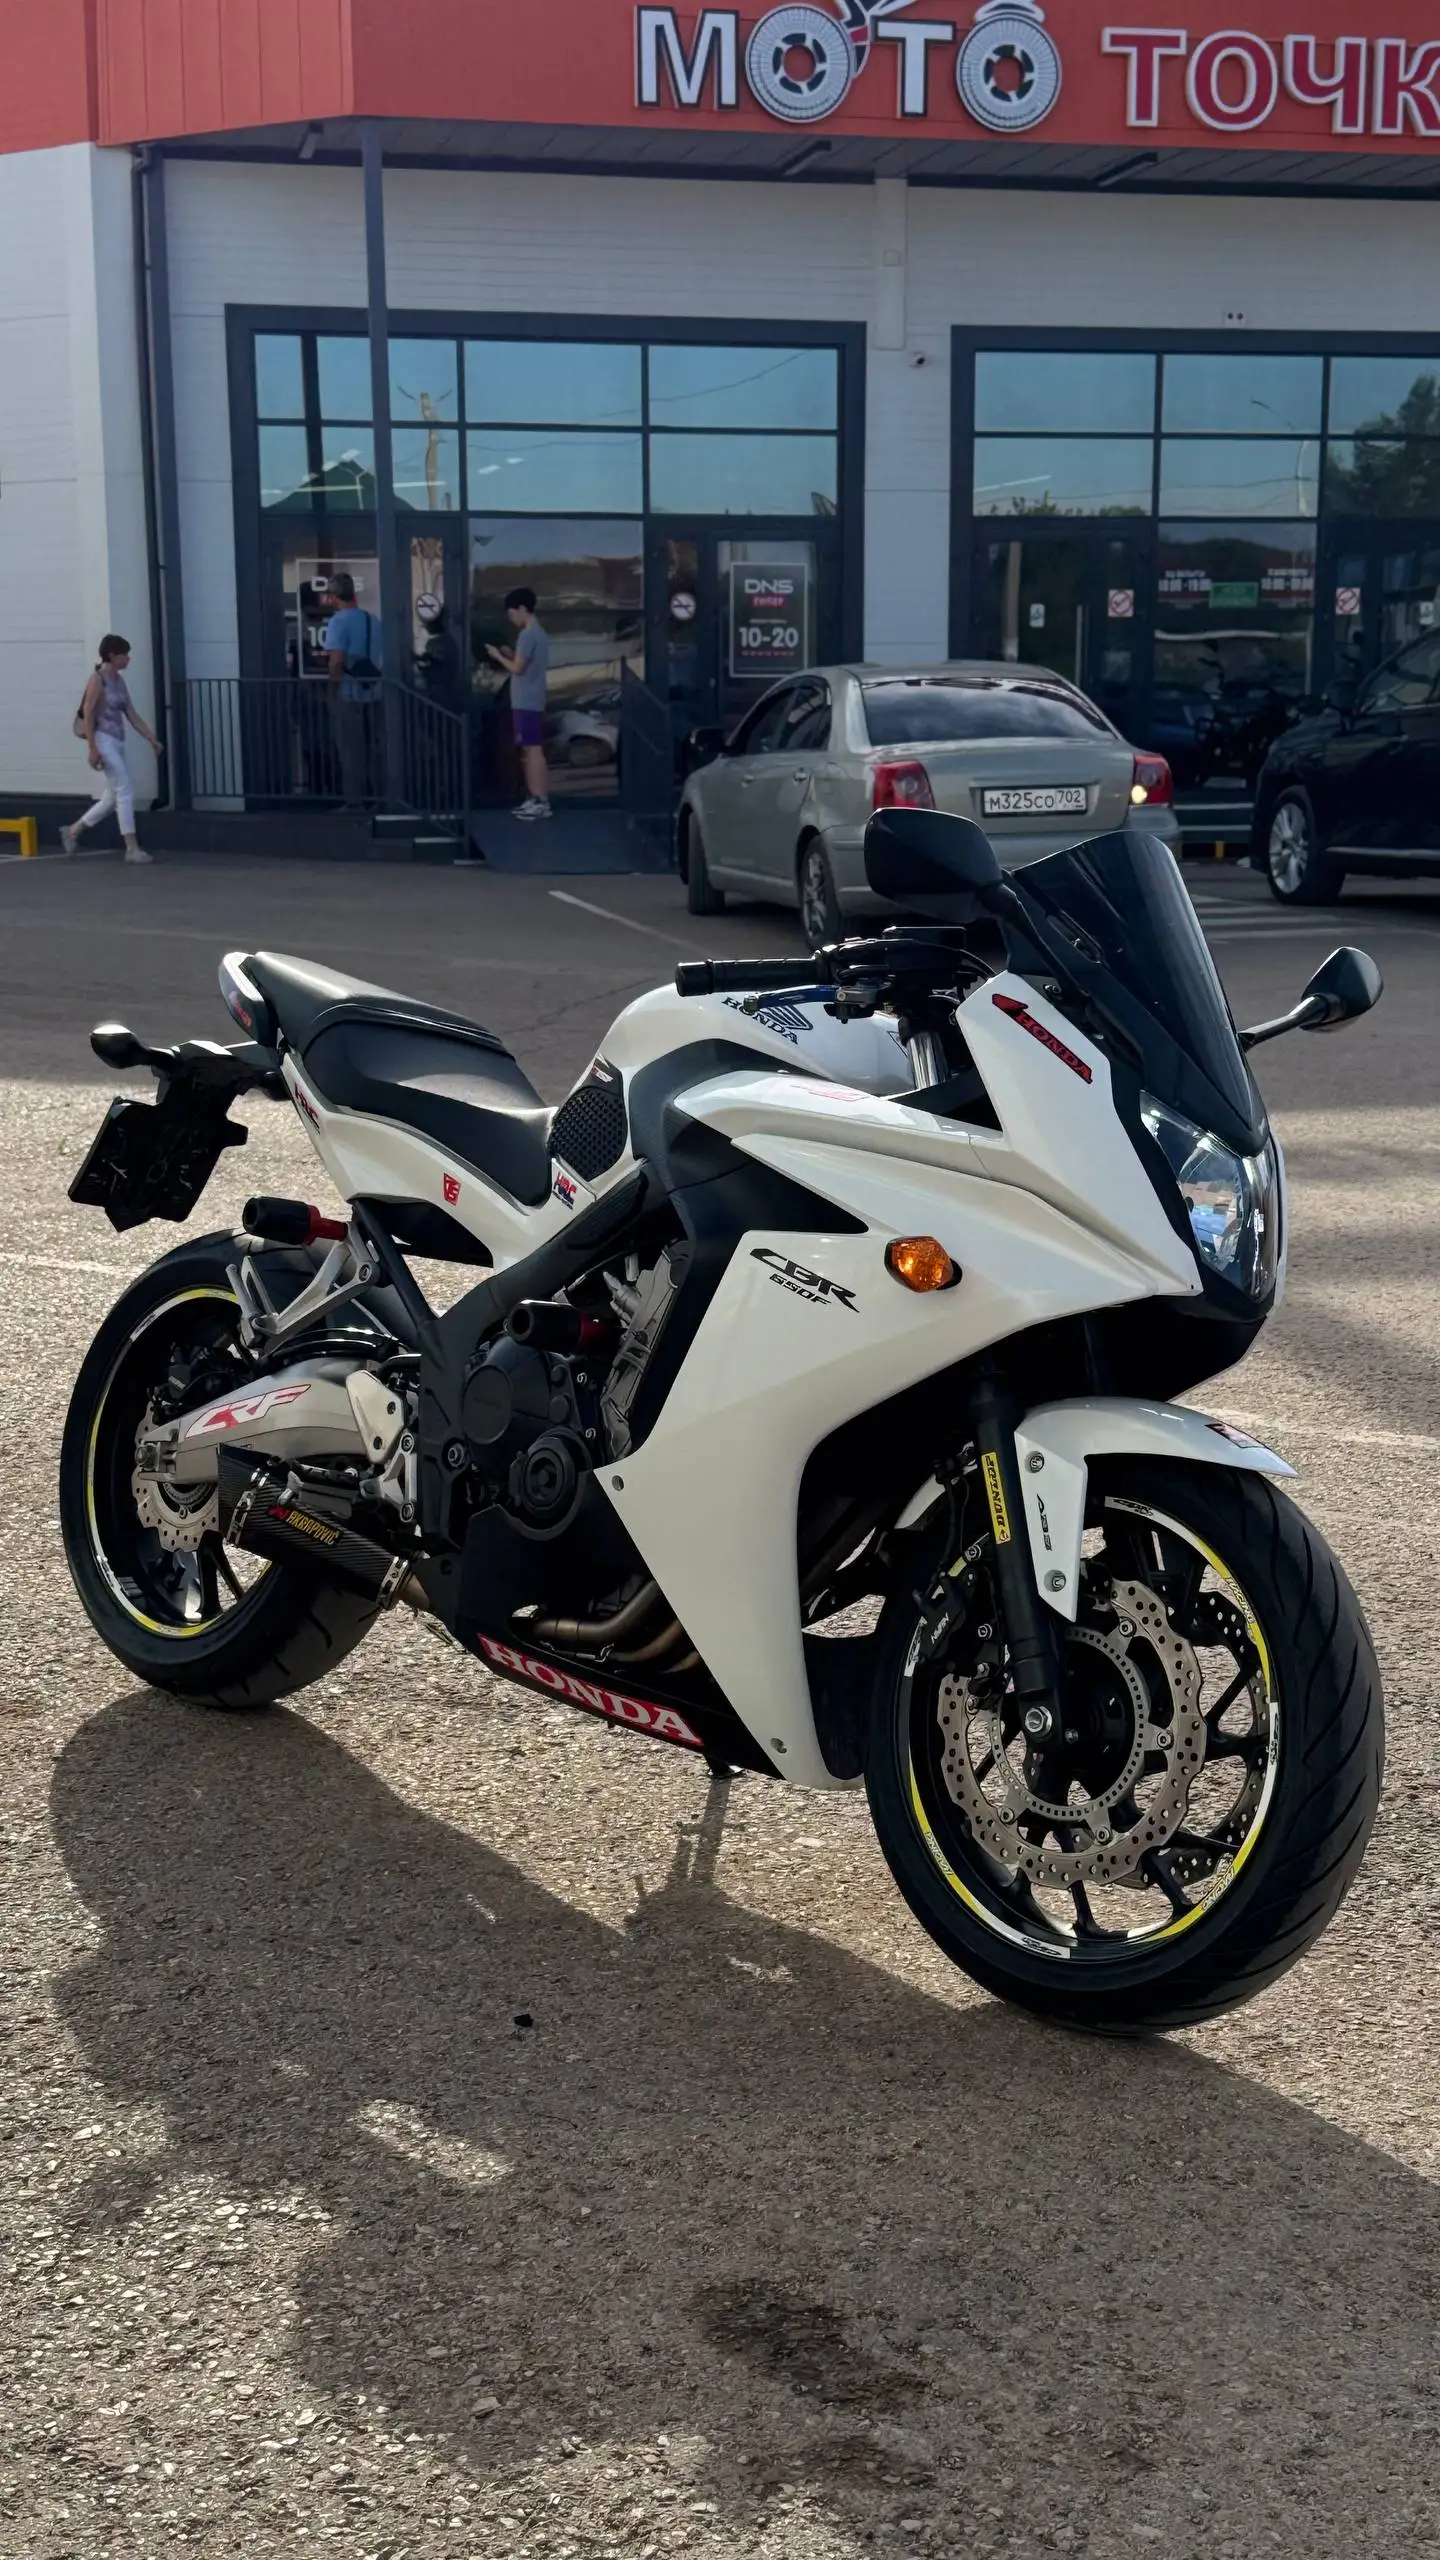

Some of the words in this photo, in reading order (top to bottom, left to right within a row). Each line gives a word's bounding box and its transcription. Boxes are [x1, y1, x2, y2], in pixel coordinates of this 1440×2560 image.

[1101, 27, 1440, 136] ТОЧК
[311, 576, 365, 592] DS
[744, 578, 794, 594] DNS
[739, 627, 799, 648] 10-20
[1057, 790, 1081, 804] 702
[750, 1248, 860, 1313] CBR
[769, 1273, 832, 1305] 650F
[184, 1384, 312, 1439] CRF
[480, 1636, 701, 1744] HONDA
